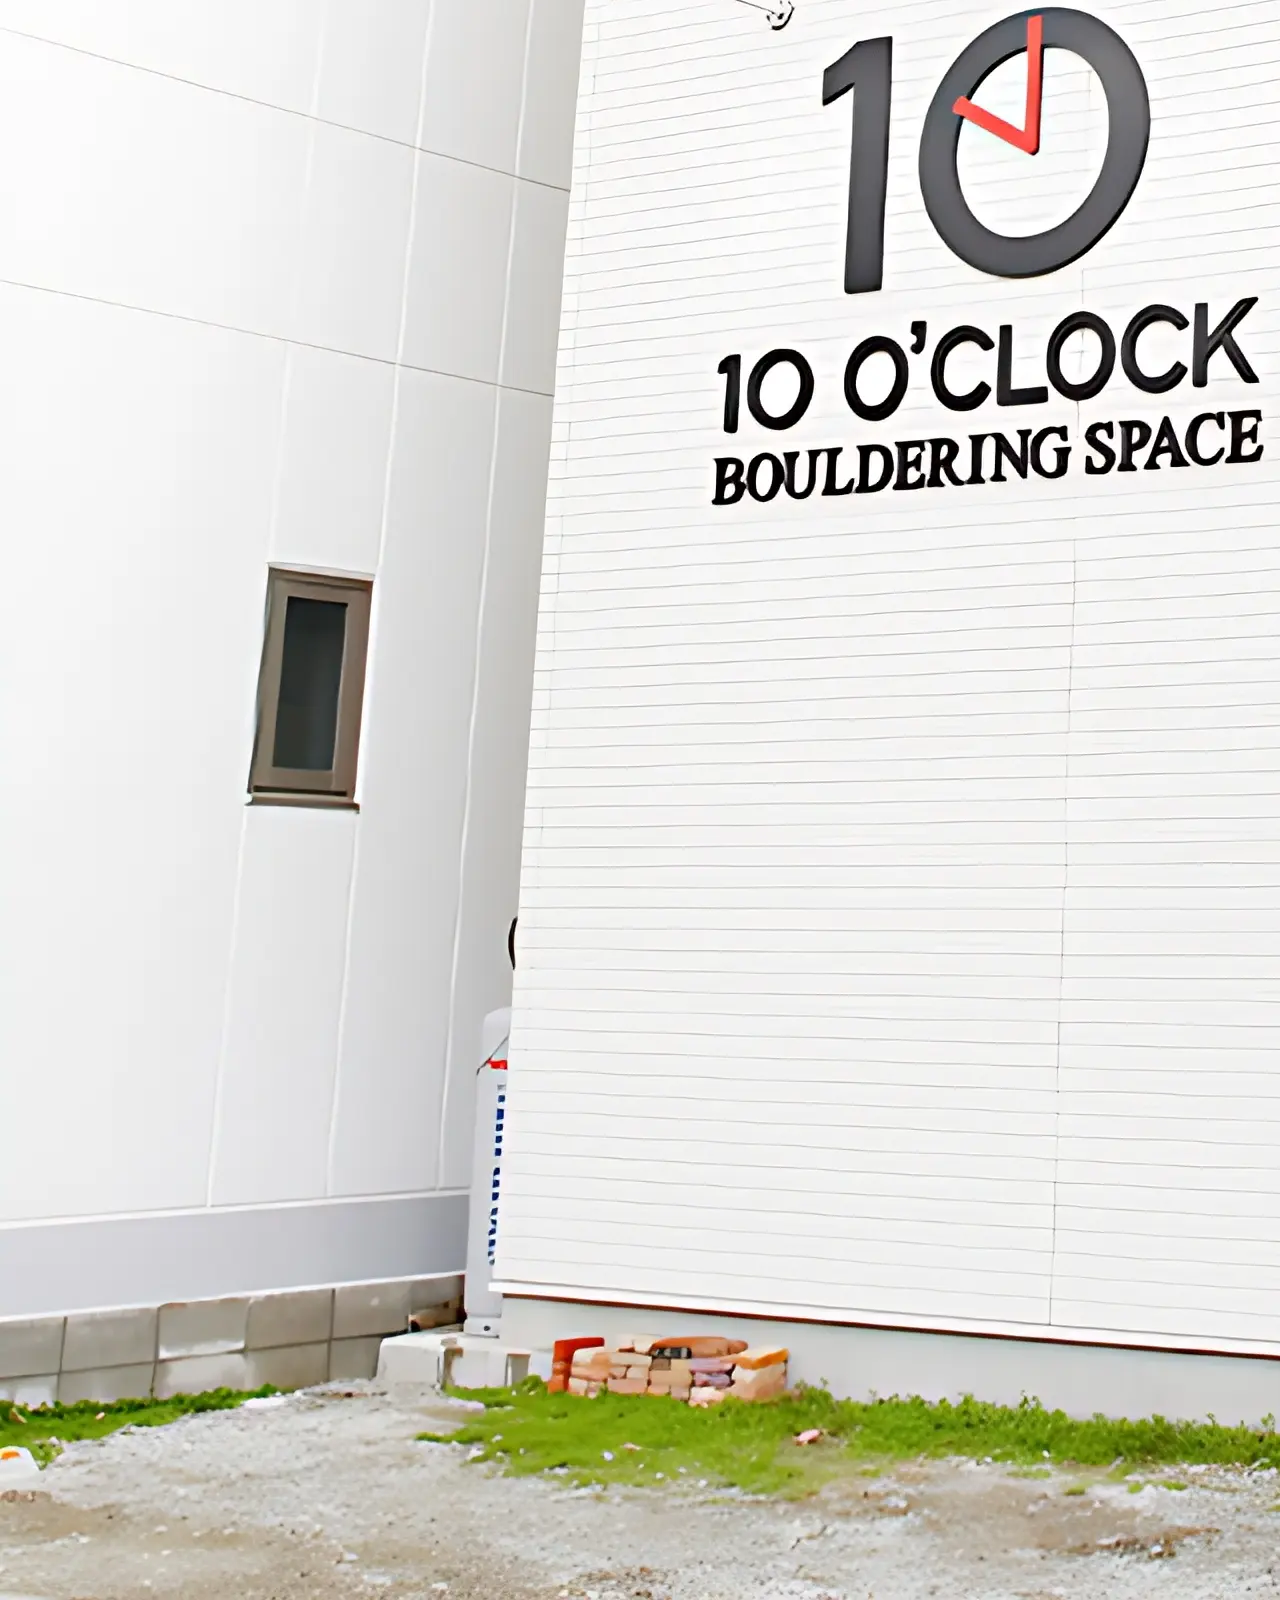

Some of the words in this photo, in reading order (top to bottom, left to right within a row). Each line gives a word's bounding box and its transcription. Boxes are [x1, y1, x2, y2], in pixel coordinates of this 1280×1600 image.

[822, 6, 1152, 295] 10
[717, 347, 815, 434] 10
[842, 296, 1260, 422] O'CLOCK
[711, 425, 1072, 506] BOULDERING
[1084, 409, 1264, 475] SPACE
